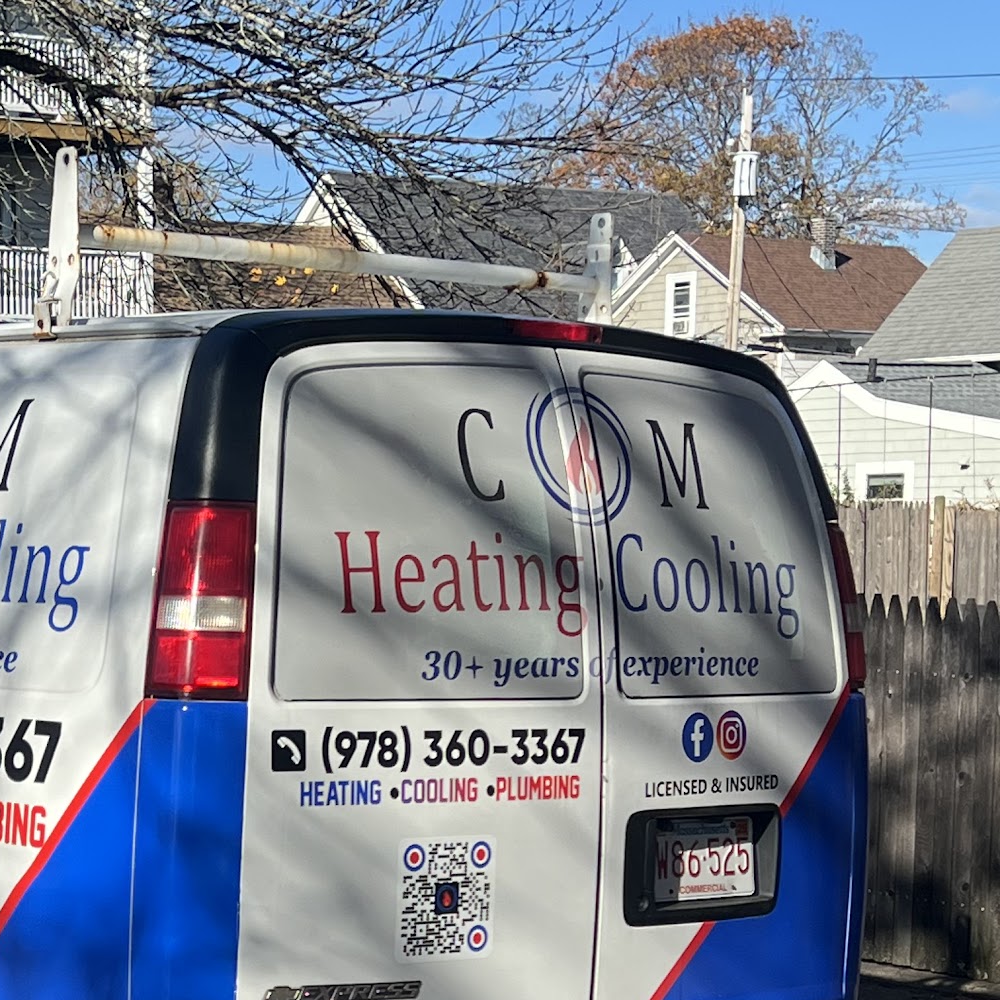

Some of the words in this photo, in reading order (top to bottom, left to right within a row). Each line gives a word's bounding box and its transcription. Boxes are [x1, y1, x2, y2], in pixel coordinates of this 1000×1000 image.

[457, 407, 505, 502] C
[646, 418, 710, 510] M
[334, 530, 588, 637] Heating
[615, 532, 800, 640] Cooling
[421, 650, 484, 681] 30+
[494, 654, 580, 687] years
[589, 647, 617, 684] of
[622, 646, 760, 684] experience
[321, 725, 411, 773] (978)
[423, 728, 586, 767] 360-3367
[300, 779, 382, 807] HEATING
[645, 779, 707, 798] LICENSED
[710, 778, 722, 794] &
[725, 774, 779, 792] INSURED
[679, 884, 728, 895] COMMERCIAL
